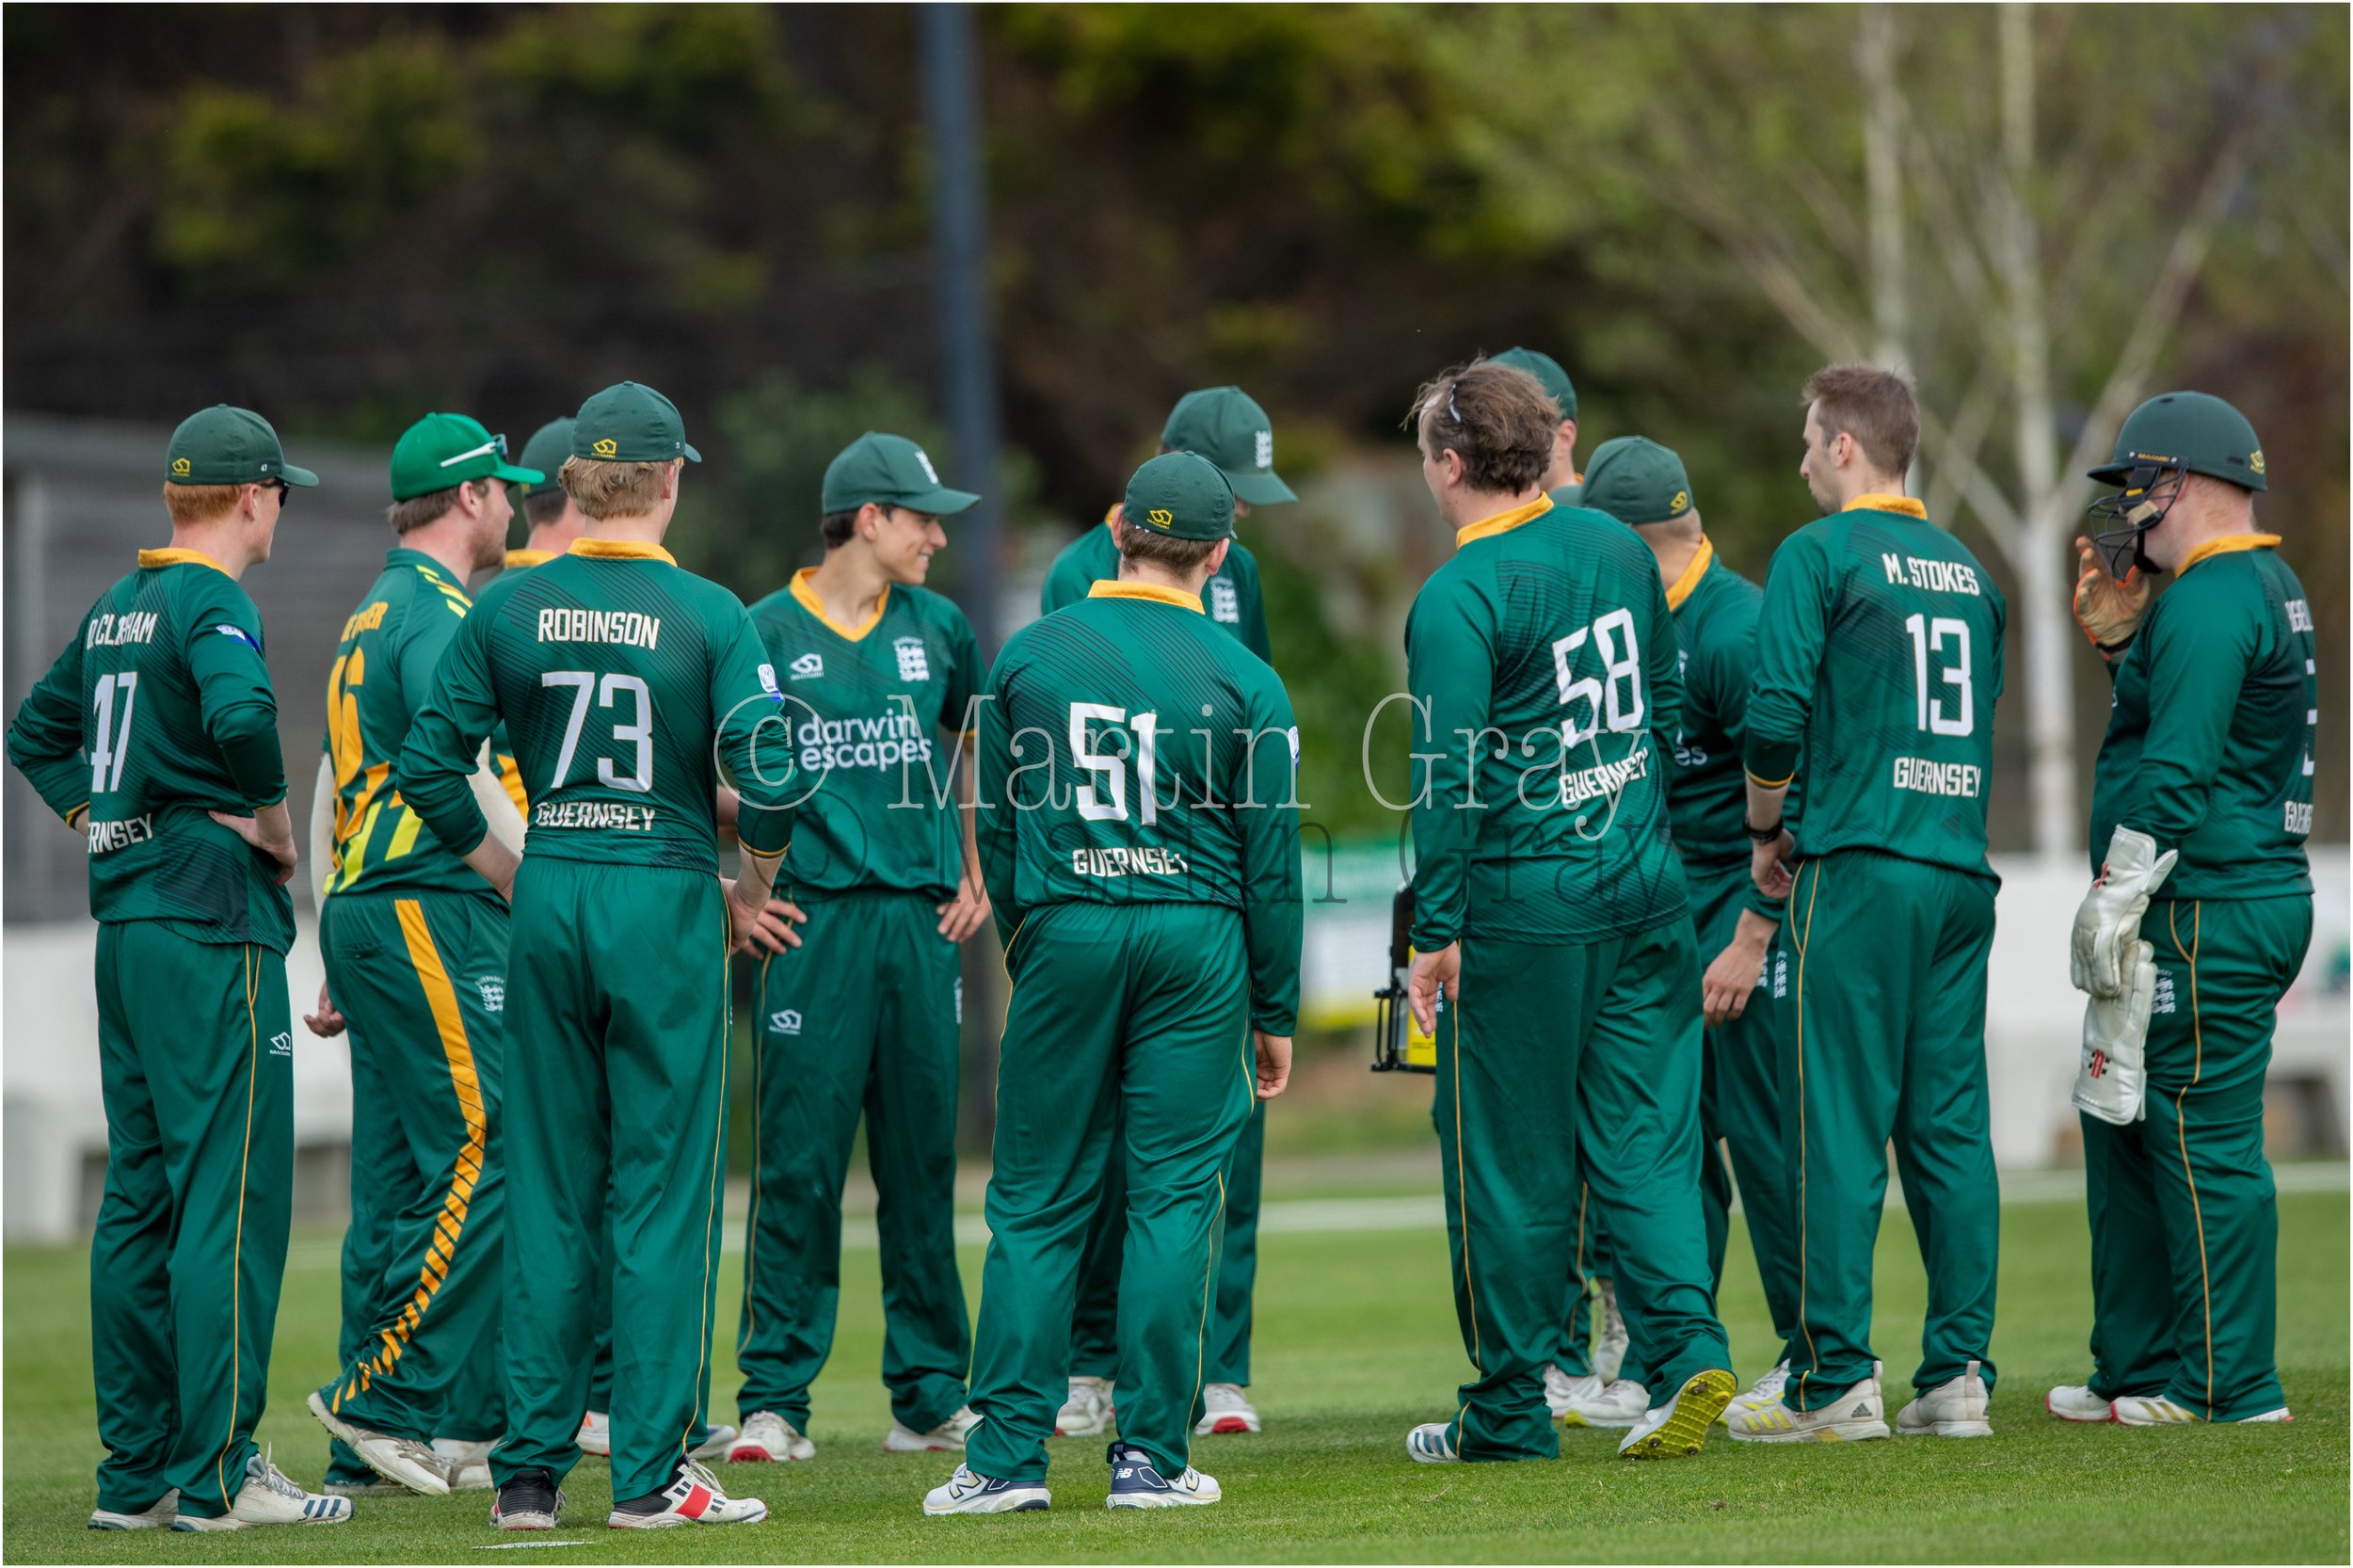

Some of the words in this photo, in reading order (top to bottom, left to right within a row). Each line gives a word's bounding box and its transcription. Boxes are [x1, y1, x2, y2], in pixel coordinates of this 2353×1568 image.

[1881, 552, 1909, 584] M.
[1907, 556, 1980, 597] STOKES
[537, 608, 661, 650] ROBINSON
[1551, 607, 1645, 749] 58
[1905, 613, 1974, 737] 13
[90, 671, 138, 793] 47
[541, 670, 653, 793] 73
[797, 707, 919, 746] darwin
[800, 738, 933, 773] escapes
[1068, 701, 1158, 826] 51
[1893, 756, 1982, 798] GUERNSEY
[88, 812, 153, 854] RNSEY
[535, 801, 656, 831] GUERNSEY
